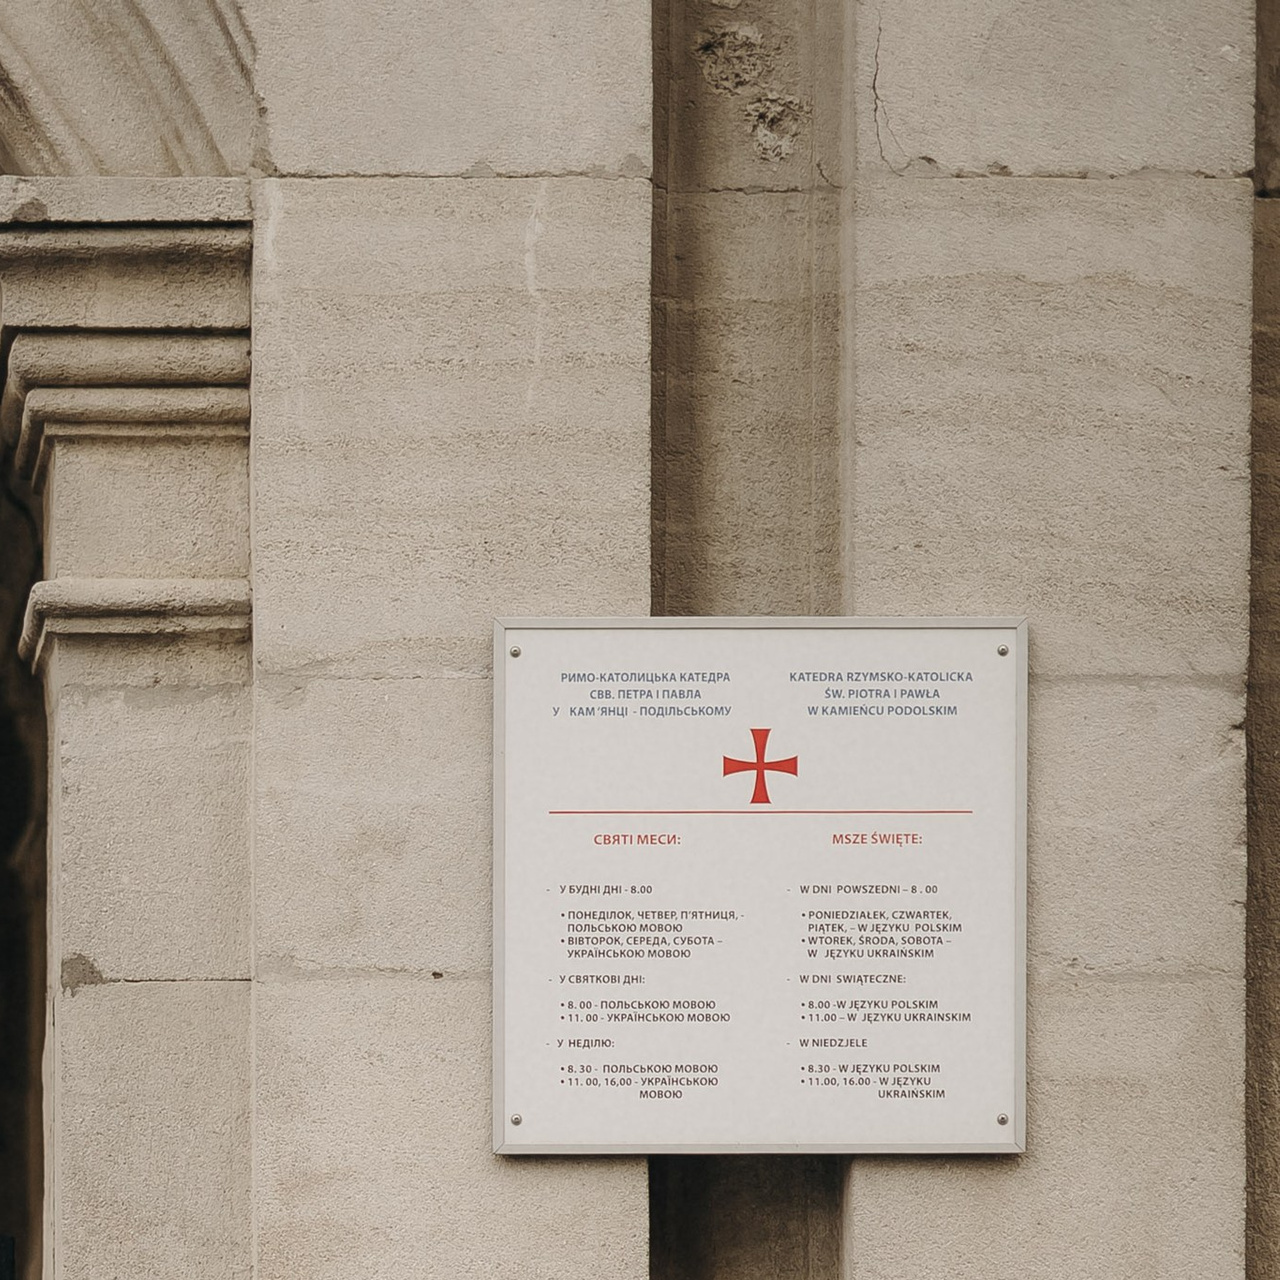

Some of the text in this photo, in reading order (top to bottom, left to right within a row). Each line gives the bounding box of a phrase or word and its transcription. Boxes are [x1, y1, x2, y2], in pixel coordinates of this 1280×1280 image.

[560, 671, 731, 684] РИМО-КАТОЛИЦЬКА КАТЕДРА
[789, 671, 973, 681] KATEDRA RZYMSKO-KATOLICKA
[589, 689, 615, 699] СВВ.
[618, 689, 653, 699] ПЕТРА
[662, 689, 701, 699] ПАВЛА
[824, 686, 845, 698] ŚW.
[848, 688, 890, 698] PIOTRA
[900, 688, 940, 698] PAWŁA
[552, 706, 560, 716] У
[639, 705, 732, 718] ПОДІЛЬСЬКОМУ
[807, 703, 958, 715] W KAMIEŃCU PODOLSKIM
[593, 833, 681, 845] СВЯТІ МЕСИ:
[832, 830, 923, 847] MSZE ŚWIĘTE:
[559, 884, 567, 894] У
[568, 884, 601, 896] БУДНІ
[602, 884, 622, 896] ДНІ
[630, 884, 653, 894] 8.00
[800, 884, 810, 893] W
[812, 884, 832, 893] DNI
[836, 884, 900, 894] POWSZEDNI
[567, 910, 635, 921] ПОНЕДІЛОК,
[637, 910, 679, 920] ЧЕТВЕР,
[808, 910, 952, 920] PONIEDZIAŁEK, CZWARTEK,
[567, 923, 683, 932] ПОЛЬСЬКОЮ МОВОЮ
[808, 922, 848, 934] PIĄTEK,
[857, 923, 868, 932] W
[870, 922, 910, 934] JĘZYKU
[915, 922, 962, 932] POLSKIM
[567, 935, 624, 946] ВІВТОРОК,
[626, 935, 671, 947] СЕРЕДА,
[673, 935, 715, 945] СУБОТА
[808, 935, 856, 946] WTOREK,
[858, 932, 899, 946] ŚRODA,
[900, 935, 944, 945] SOBOTA
[567, 946, 691, 958] УКРАЇНСЬКОЮ МОВОЮ
[807, 946, 934, 960] W JĘZYKU UKRAIŃSKIM
[559, 974, 646, 985] У СВЯТКОВІ ДНІ:
[799, 974, 810, 983] W
[812, 974, 832, 983] DNI
[600, 999, 670, 1009] ПОЛЬСЬКОЮ
[672, 999, 716, 1009] МОВОЮ
[807, 1000, 831, 1009] 8.00
[848, 999, 888, 1011] JĘZYKU
[891, 999, 939, 1009] POLSKIM
[606, 1010, 685, 1022] УКРАЇНСЬКОЮ
[687, 1012, 731, 1022] МОВОЮ
[808, 1012, 837, 1022] 11.00
[847, 1012, 857, 1021] W
[861, 1012, 902, 1024] JĘZYKU
[556, 1038, 615, 1049] У НЕДІЛЮ:
[799, 1038, 810, 1047] W
[603, 1064, 673, 1073] ПОЛЬСЬКОЮ
[674, 1063, 719, 1073] МОВОЮ
[807, 1064, 830, 1073] 8.30
[838, 1063, 849, 1073] W
[850, 1063, 890, 1075] JĘZYKU
[893, 1063, 941, 1073] POLSKIM
[604, 1077, 632, 1087] 16,00
[640, 1074, 719, 1086] УКРАЇНСЬКОЮ
[808, 1076, 840, 1087] 11.00,
[843, 1076, 871, 1085] 16.00
[878, 1076, 889, 1085] W
[891, 1076, 931, 1089] JĘZYKU
[639, 1089, 683, 1099] МОВОЮ
[878, 1086, 946, 1098] UKRAIŃSKIM
